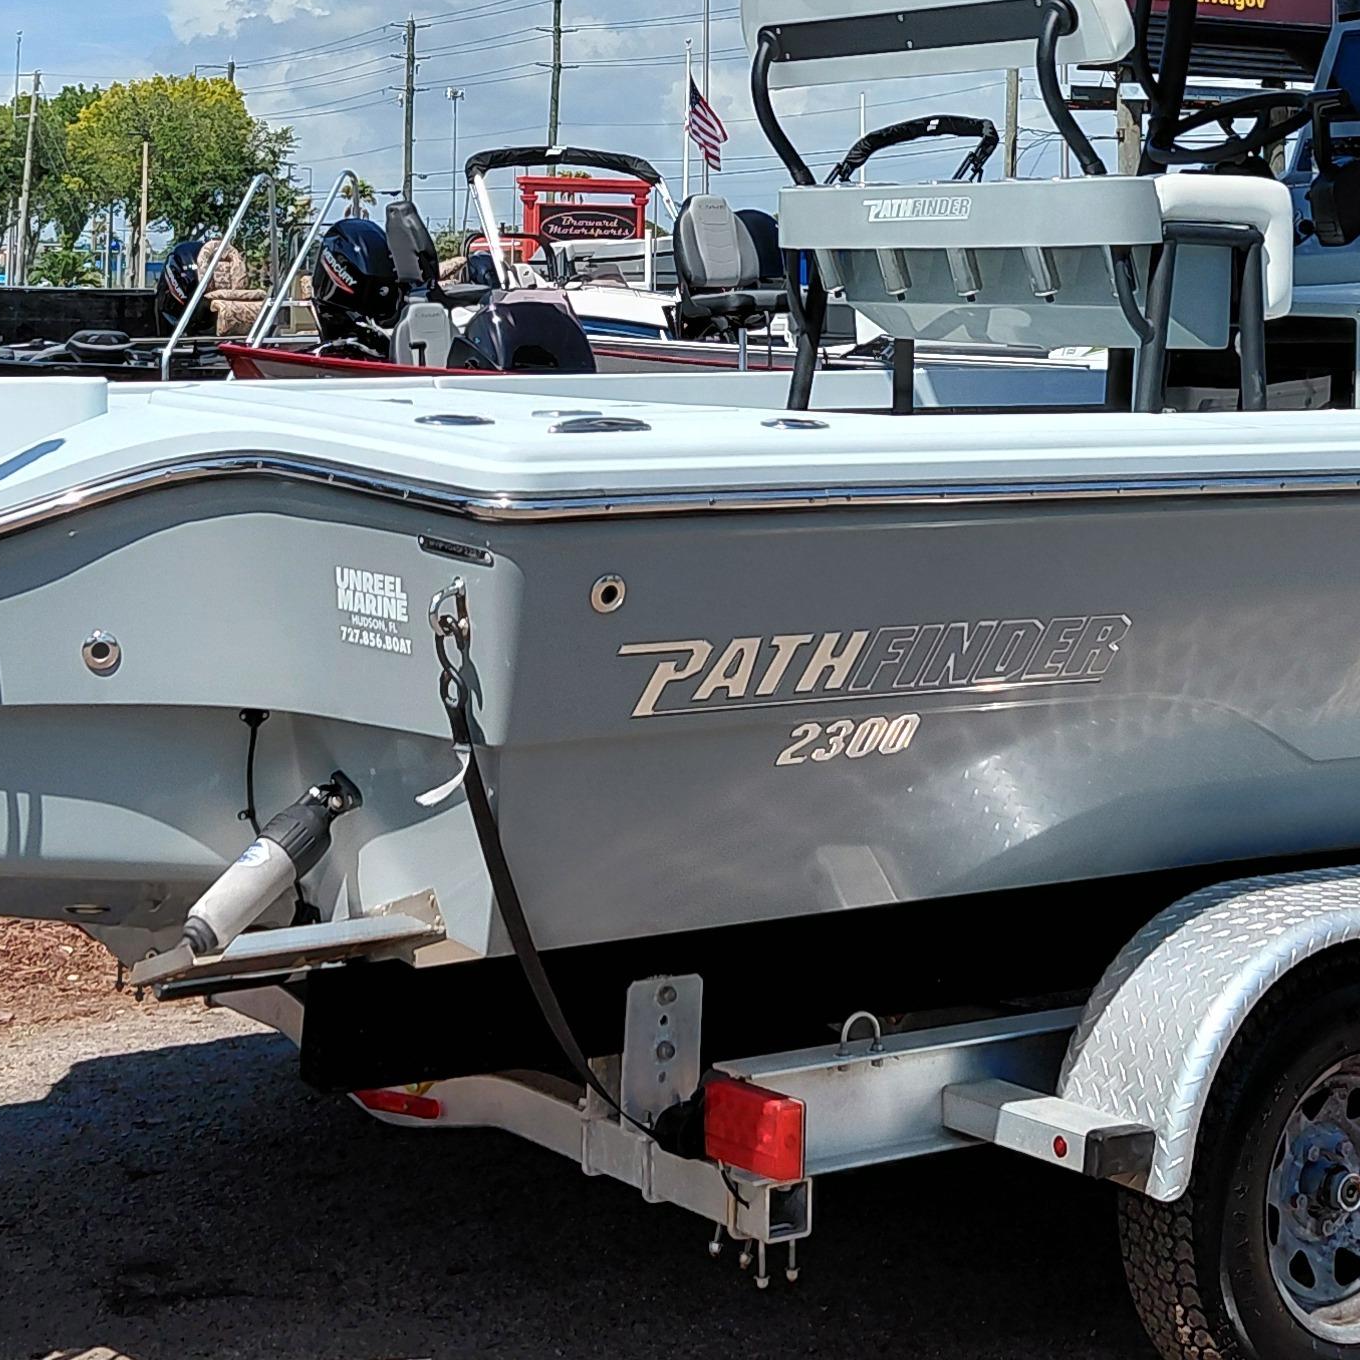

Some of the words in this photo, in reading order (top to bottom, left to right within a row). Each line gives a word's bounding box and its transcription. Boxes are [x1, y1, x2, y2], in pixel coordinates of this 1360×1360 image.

[561, 215, 619, 228] Broward
[862, 196, 973, 222] PATHFINDER
[547, 223, 630, 238] Motorsports
[335, 565, 408, 601] UNREEL
[336, 587, 410, 623] MARINE
[350, 614, 386, 633] HUDSON,
[388, 620, 399, 634] FL
[340, 625, 413, 655] 727.856.BOAT
[617, 612, 1133, 719] PATHFINDER
[774, 713, 922, 767] 2300
